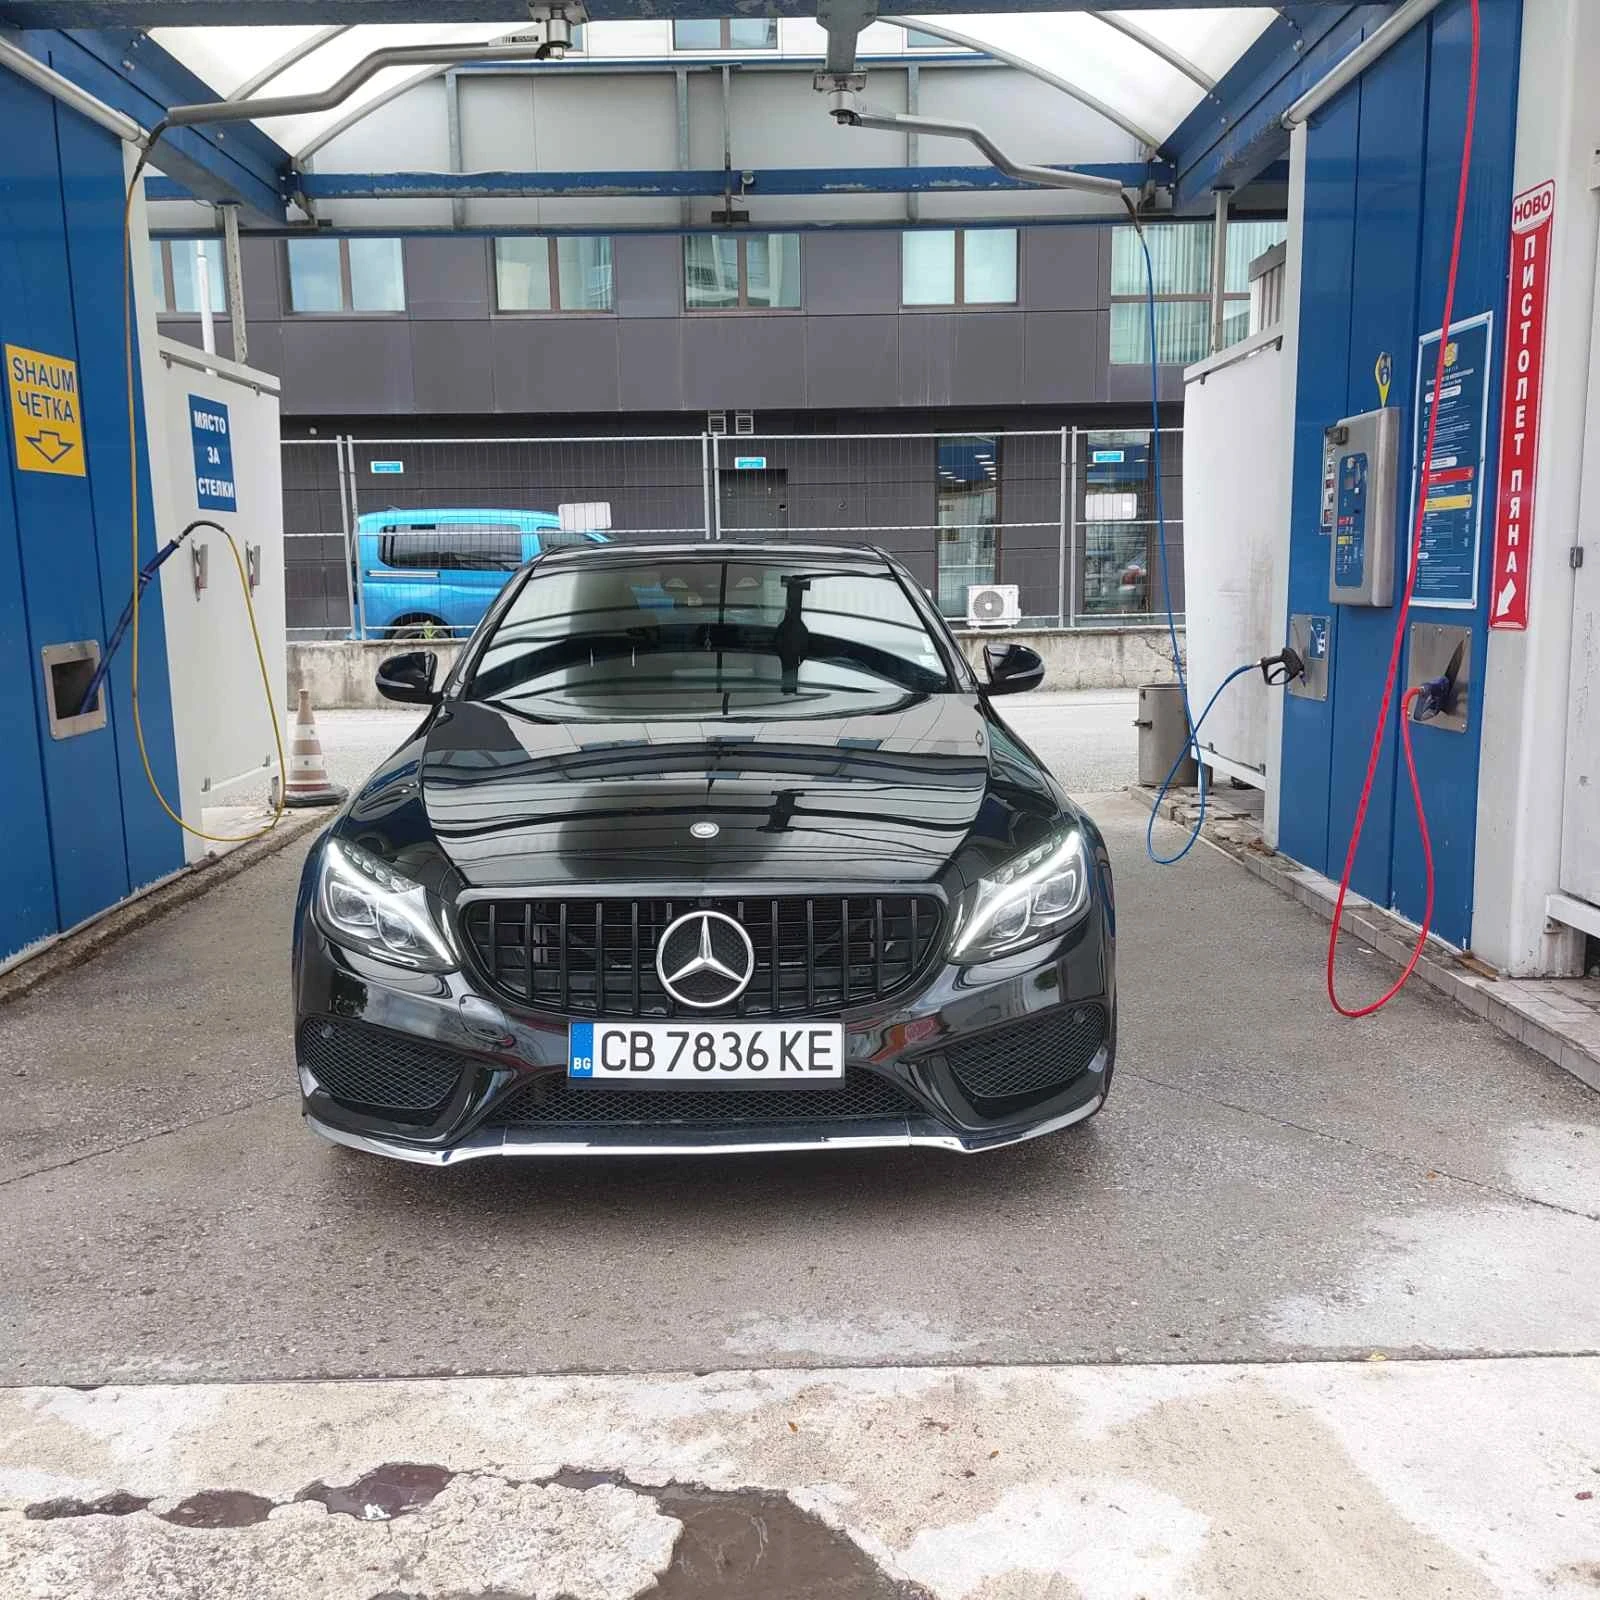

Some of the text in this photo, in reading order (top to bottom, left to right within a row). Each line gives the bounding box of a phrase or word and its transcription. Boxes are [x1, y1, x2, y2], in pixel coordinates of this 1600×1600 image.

[1514, 191, 1550, 225] НОВО
[13, 357, 76, 393] SHAUM
[17, 390, 75, 424] ЧЕТКА
[1505, 235, 1536, 573] ПИСТОЛЕТ ПЯНА
[194, 410, 226, 435] МЯСТО
[207, 446, 221, 465] ЗА
[198, 477, 235, 498] СТЕЛКИ
[573, 1057, 592, 1070] BG
[666, 1031, 769, 1072] 7836
